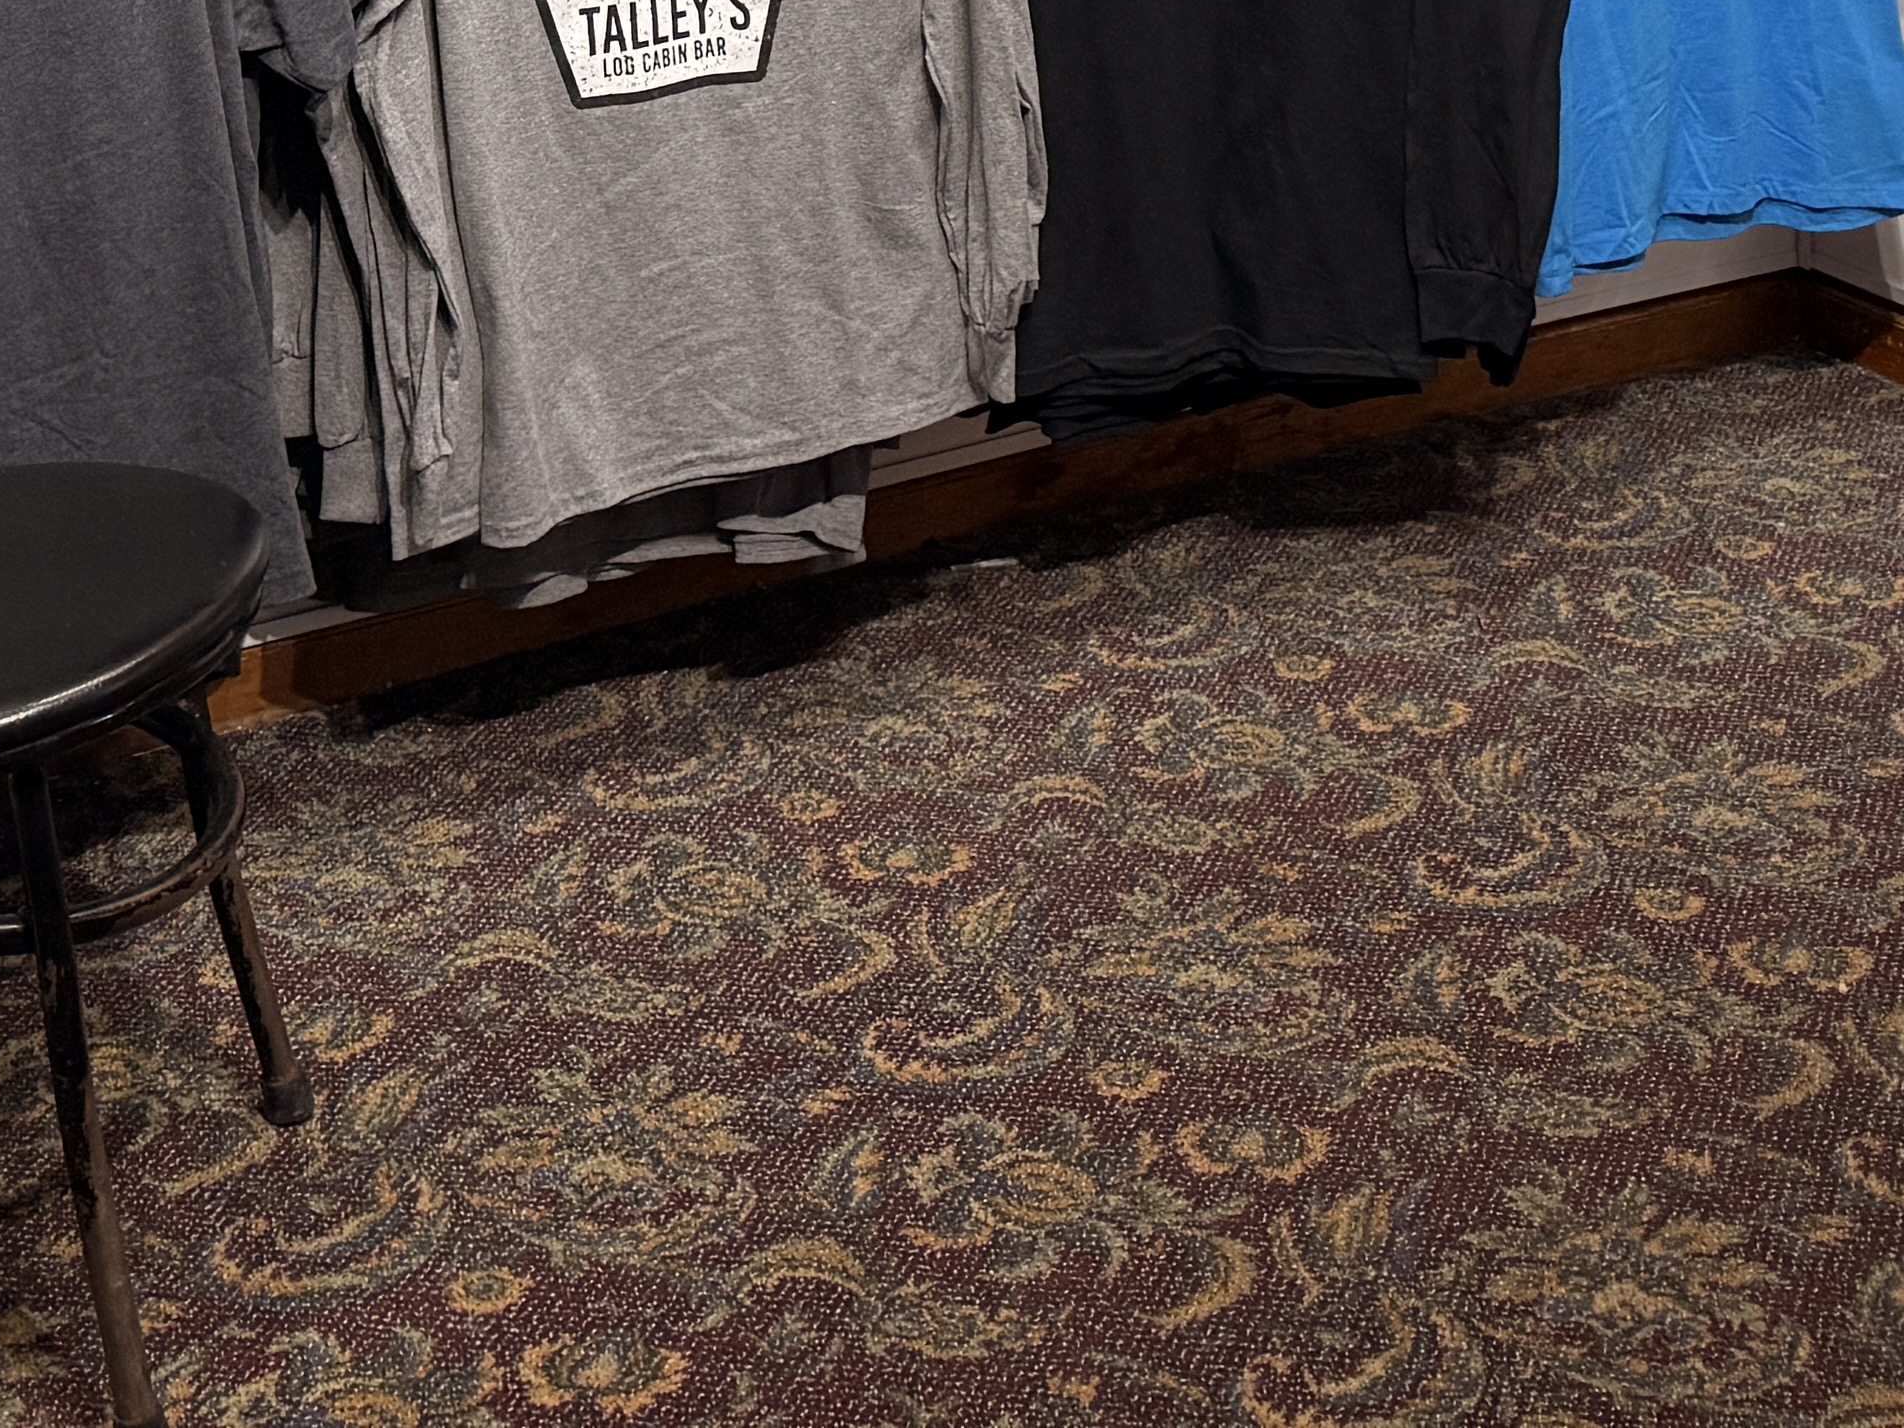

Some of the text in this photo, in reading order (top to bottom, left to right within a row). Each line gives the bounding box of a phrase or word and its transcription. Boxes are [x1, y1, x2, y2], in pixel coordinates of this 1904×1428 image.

[602, 36, 729, 78] LOG CABIN BAR
